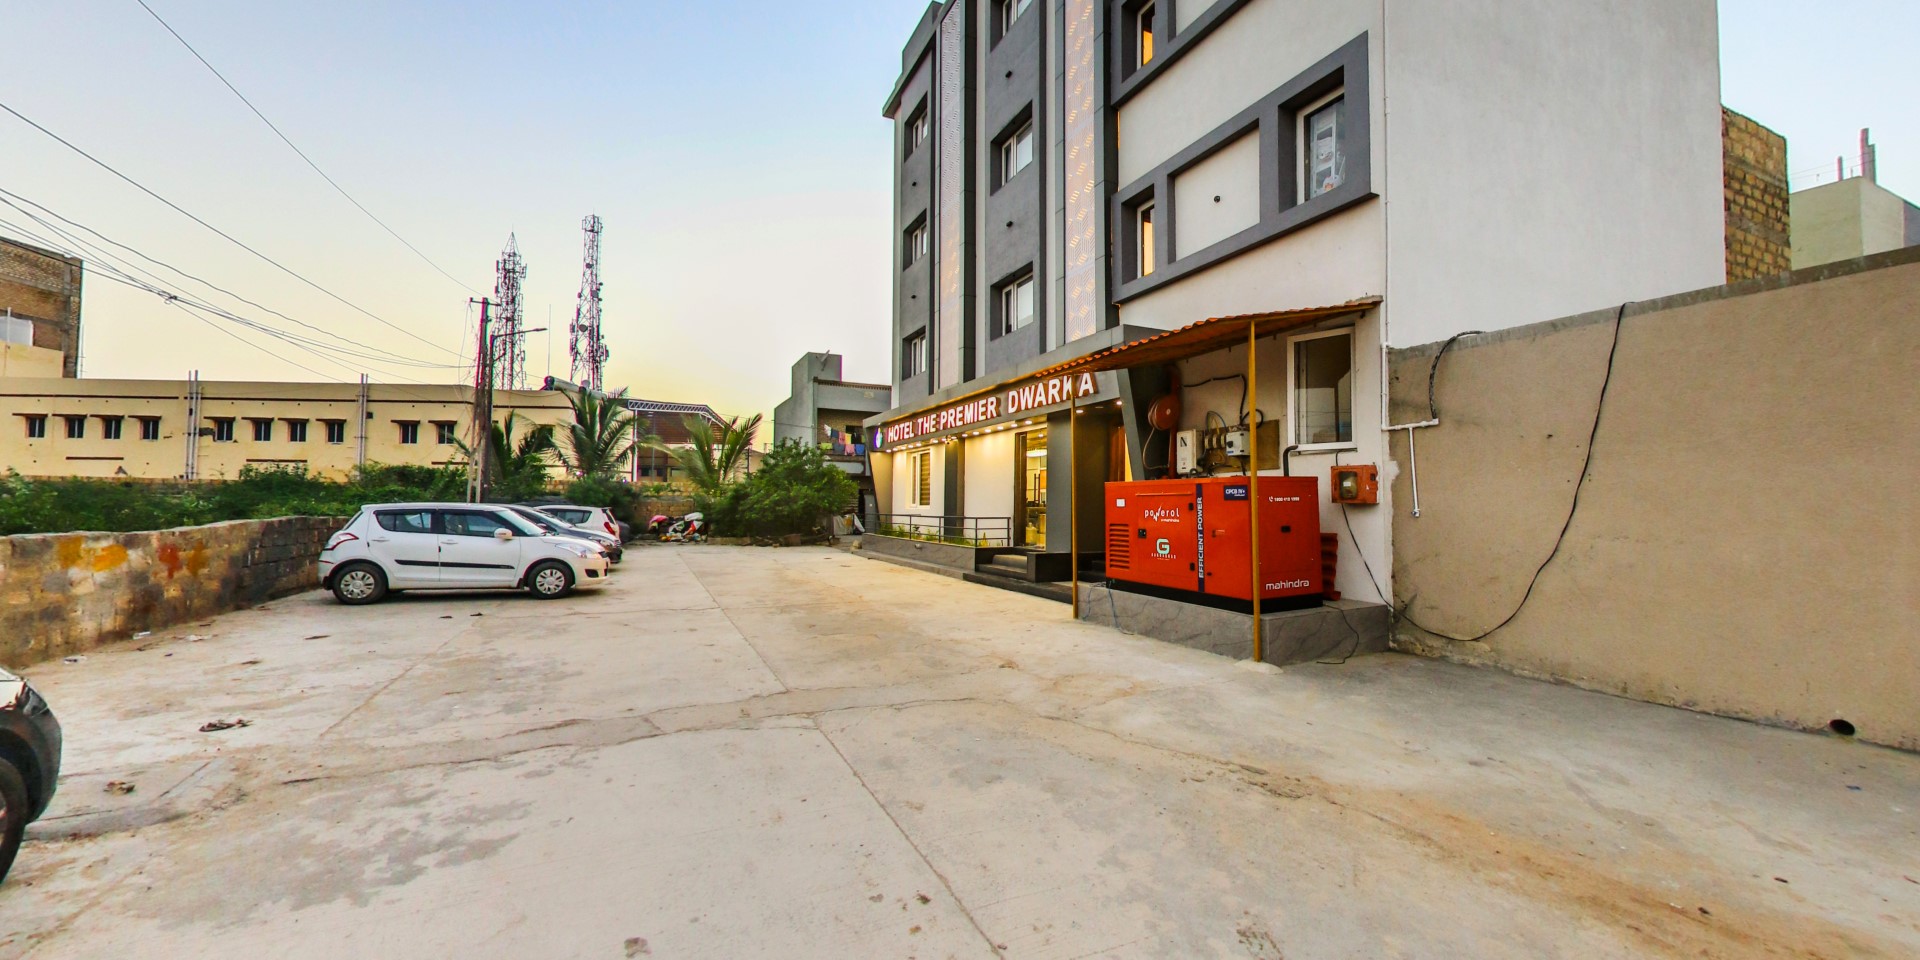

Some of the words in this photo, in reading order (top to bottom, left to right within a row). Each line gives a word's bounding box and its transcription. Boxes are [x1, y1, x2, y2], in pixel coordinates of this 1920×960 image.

[888, 421, 915, 443] HOTEL
[917, 414, 937, 436] THE
[940, 396, 997, 430] PREMIER
[1008, 372, 1094, 414] DWARKA
[1144, 505, 1180, 522] powerol
[1265, 579, 1310, 591] mahindra
